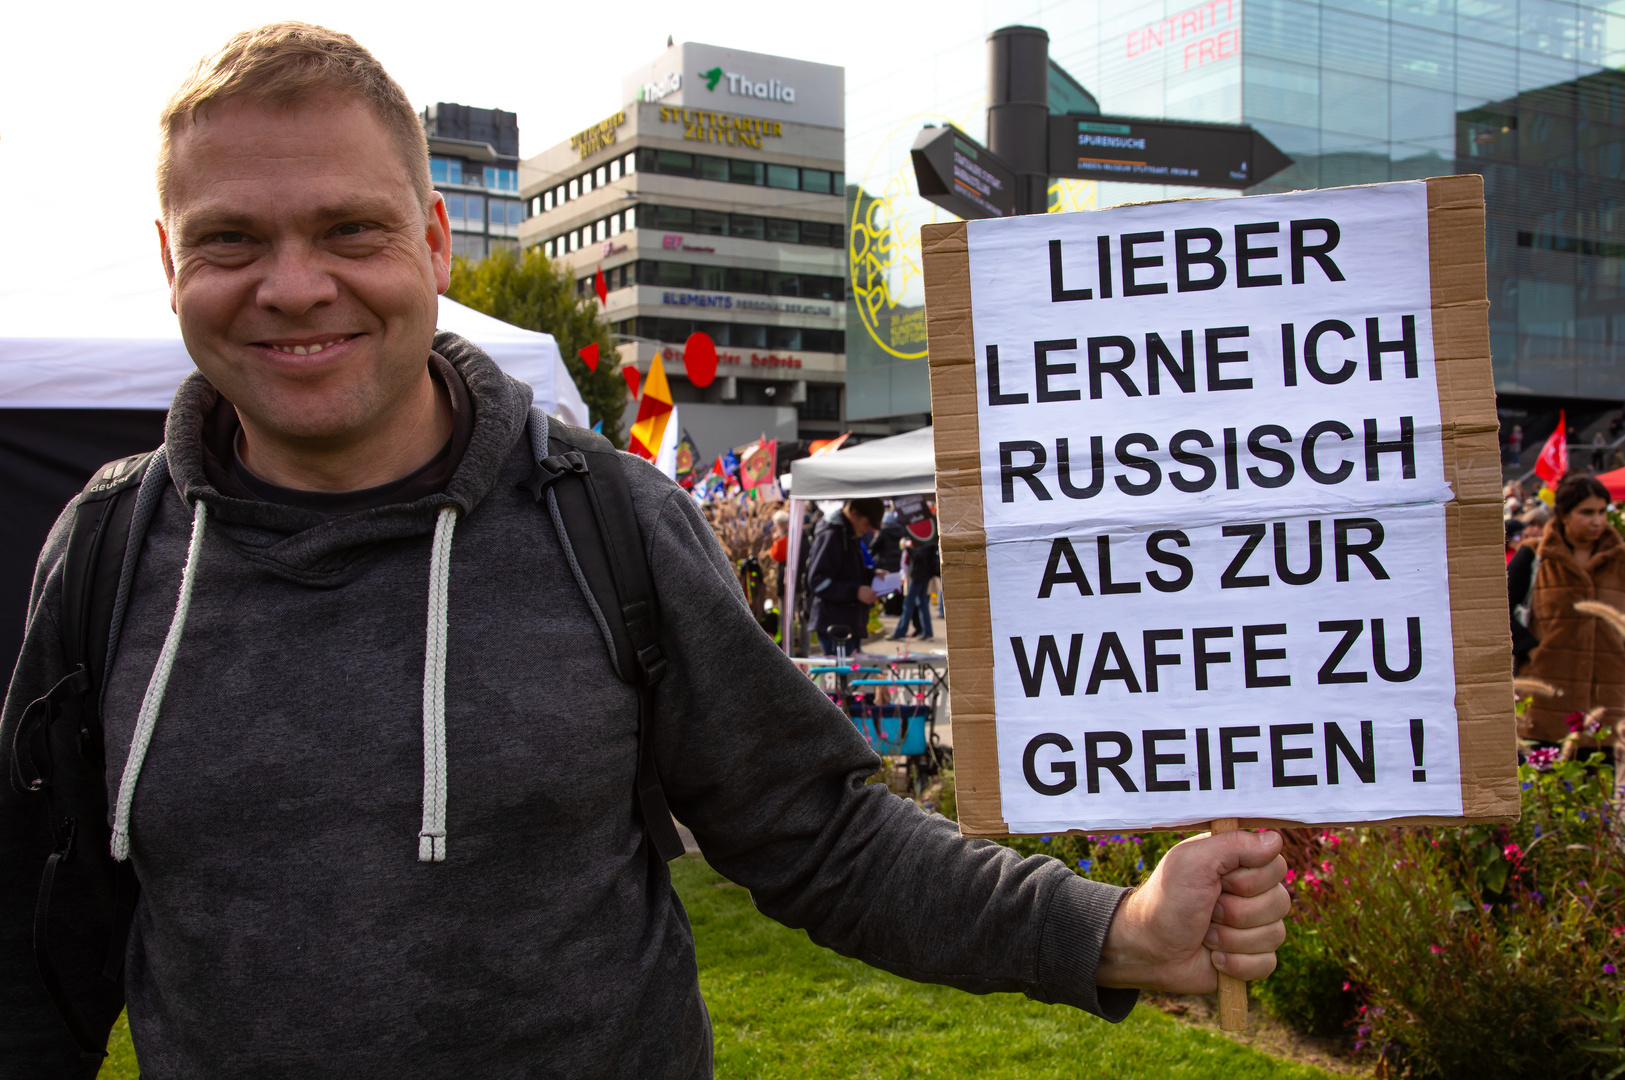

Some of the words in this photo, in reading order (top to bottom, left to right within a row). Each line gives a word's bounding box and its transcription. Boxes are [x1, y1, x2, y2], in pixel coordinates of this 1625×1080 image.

[1126, 0, 1232, 58] EINTRITT
[1184, 28, 1239, 71] FREI
[725, 71, 796, 103] Thalia
[660, 106, 783, 138] STUTTGARTER
[684, 124, 763, 149] ZEITUNG
[1078, 134, 1146, 150] SPURENSUCHE
[1048, 218, 1346, 303] LIEBER
[663, 291, 733, 309] ELEMENTS
[985, 325, 1254, 407] LERNE
[1281, 314, 1419, 387] ICH
[90, 476, 129, 493] deuter
[998, 415, 1417, 504] RUSSISCH
[1037, 529, 1194, 599] ALS
[1220, 517, 1391, 590] ZUR
[1009, 623, 1292, 698] WAFFE
[1317, 616, 1423, 685] ZU
[1022, 720, 1376, 797] GREIFEN
[1408, 718, 1428, 783] !
